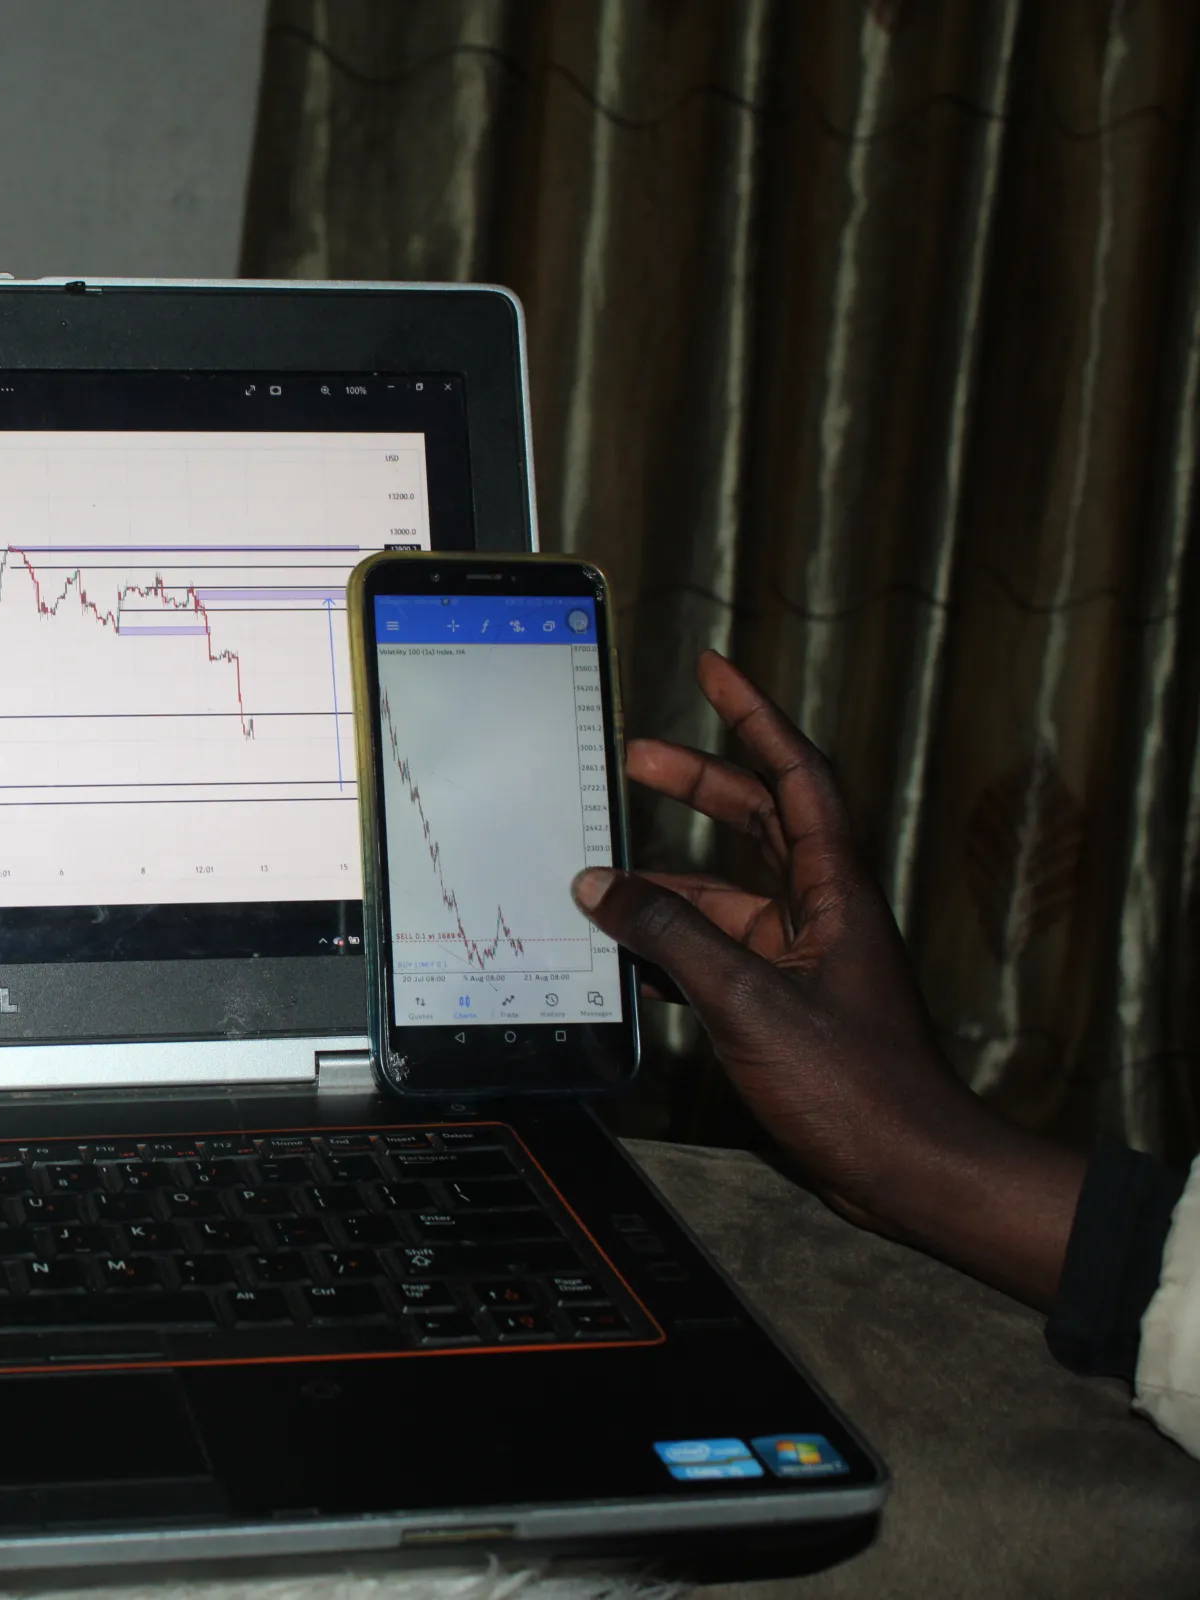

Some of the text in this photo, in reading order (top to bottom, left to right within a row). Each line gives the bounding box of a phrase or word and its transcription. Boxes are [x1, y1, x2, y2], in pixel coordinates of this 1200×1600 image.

[346, 386, 367, 395] 100%
[385, 454, 399, 462] USD
[390, 528, 416, 536] 13000.0
[379, 648, 407, 656] Volatility
[60, 868, 64, 876] 6
[141, 867, 146, 875] 8
[339, 863, 348, 871] 15
[470, 975, 484, 983] Aug
[534, 974, 548, 982] Aug
[540, 1010, 566, 1018] History
[580, 1010, 613, 1018] Messages
[398, 1154, 458, 1162] Backspace
[58, 1179, 67, 1187] 8
[173, 1193, 190, 1202] O
[243, 1191, 255, 1200] P
[29, 1198, 44, 1207] U
[131, 1226, 146, 1236] K
[205, 1224, 216, 1233] L
[60, 1229, 69, 1238] J
[405, 1248, 435, 1256] Shift
[33, 1262, 49, 1273] N
[108, 1260, 126, 1270] M
[554, 1278, 583, 1286] Page
[311, 1287, 335, 1296] Ctrl
[405, 1290, 423, 1299] Up
[236, 1292, 255, 1300] Alt
